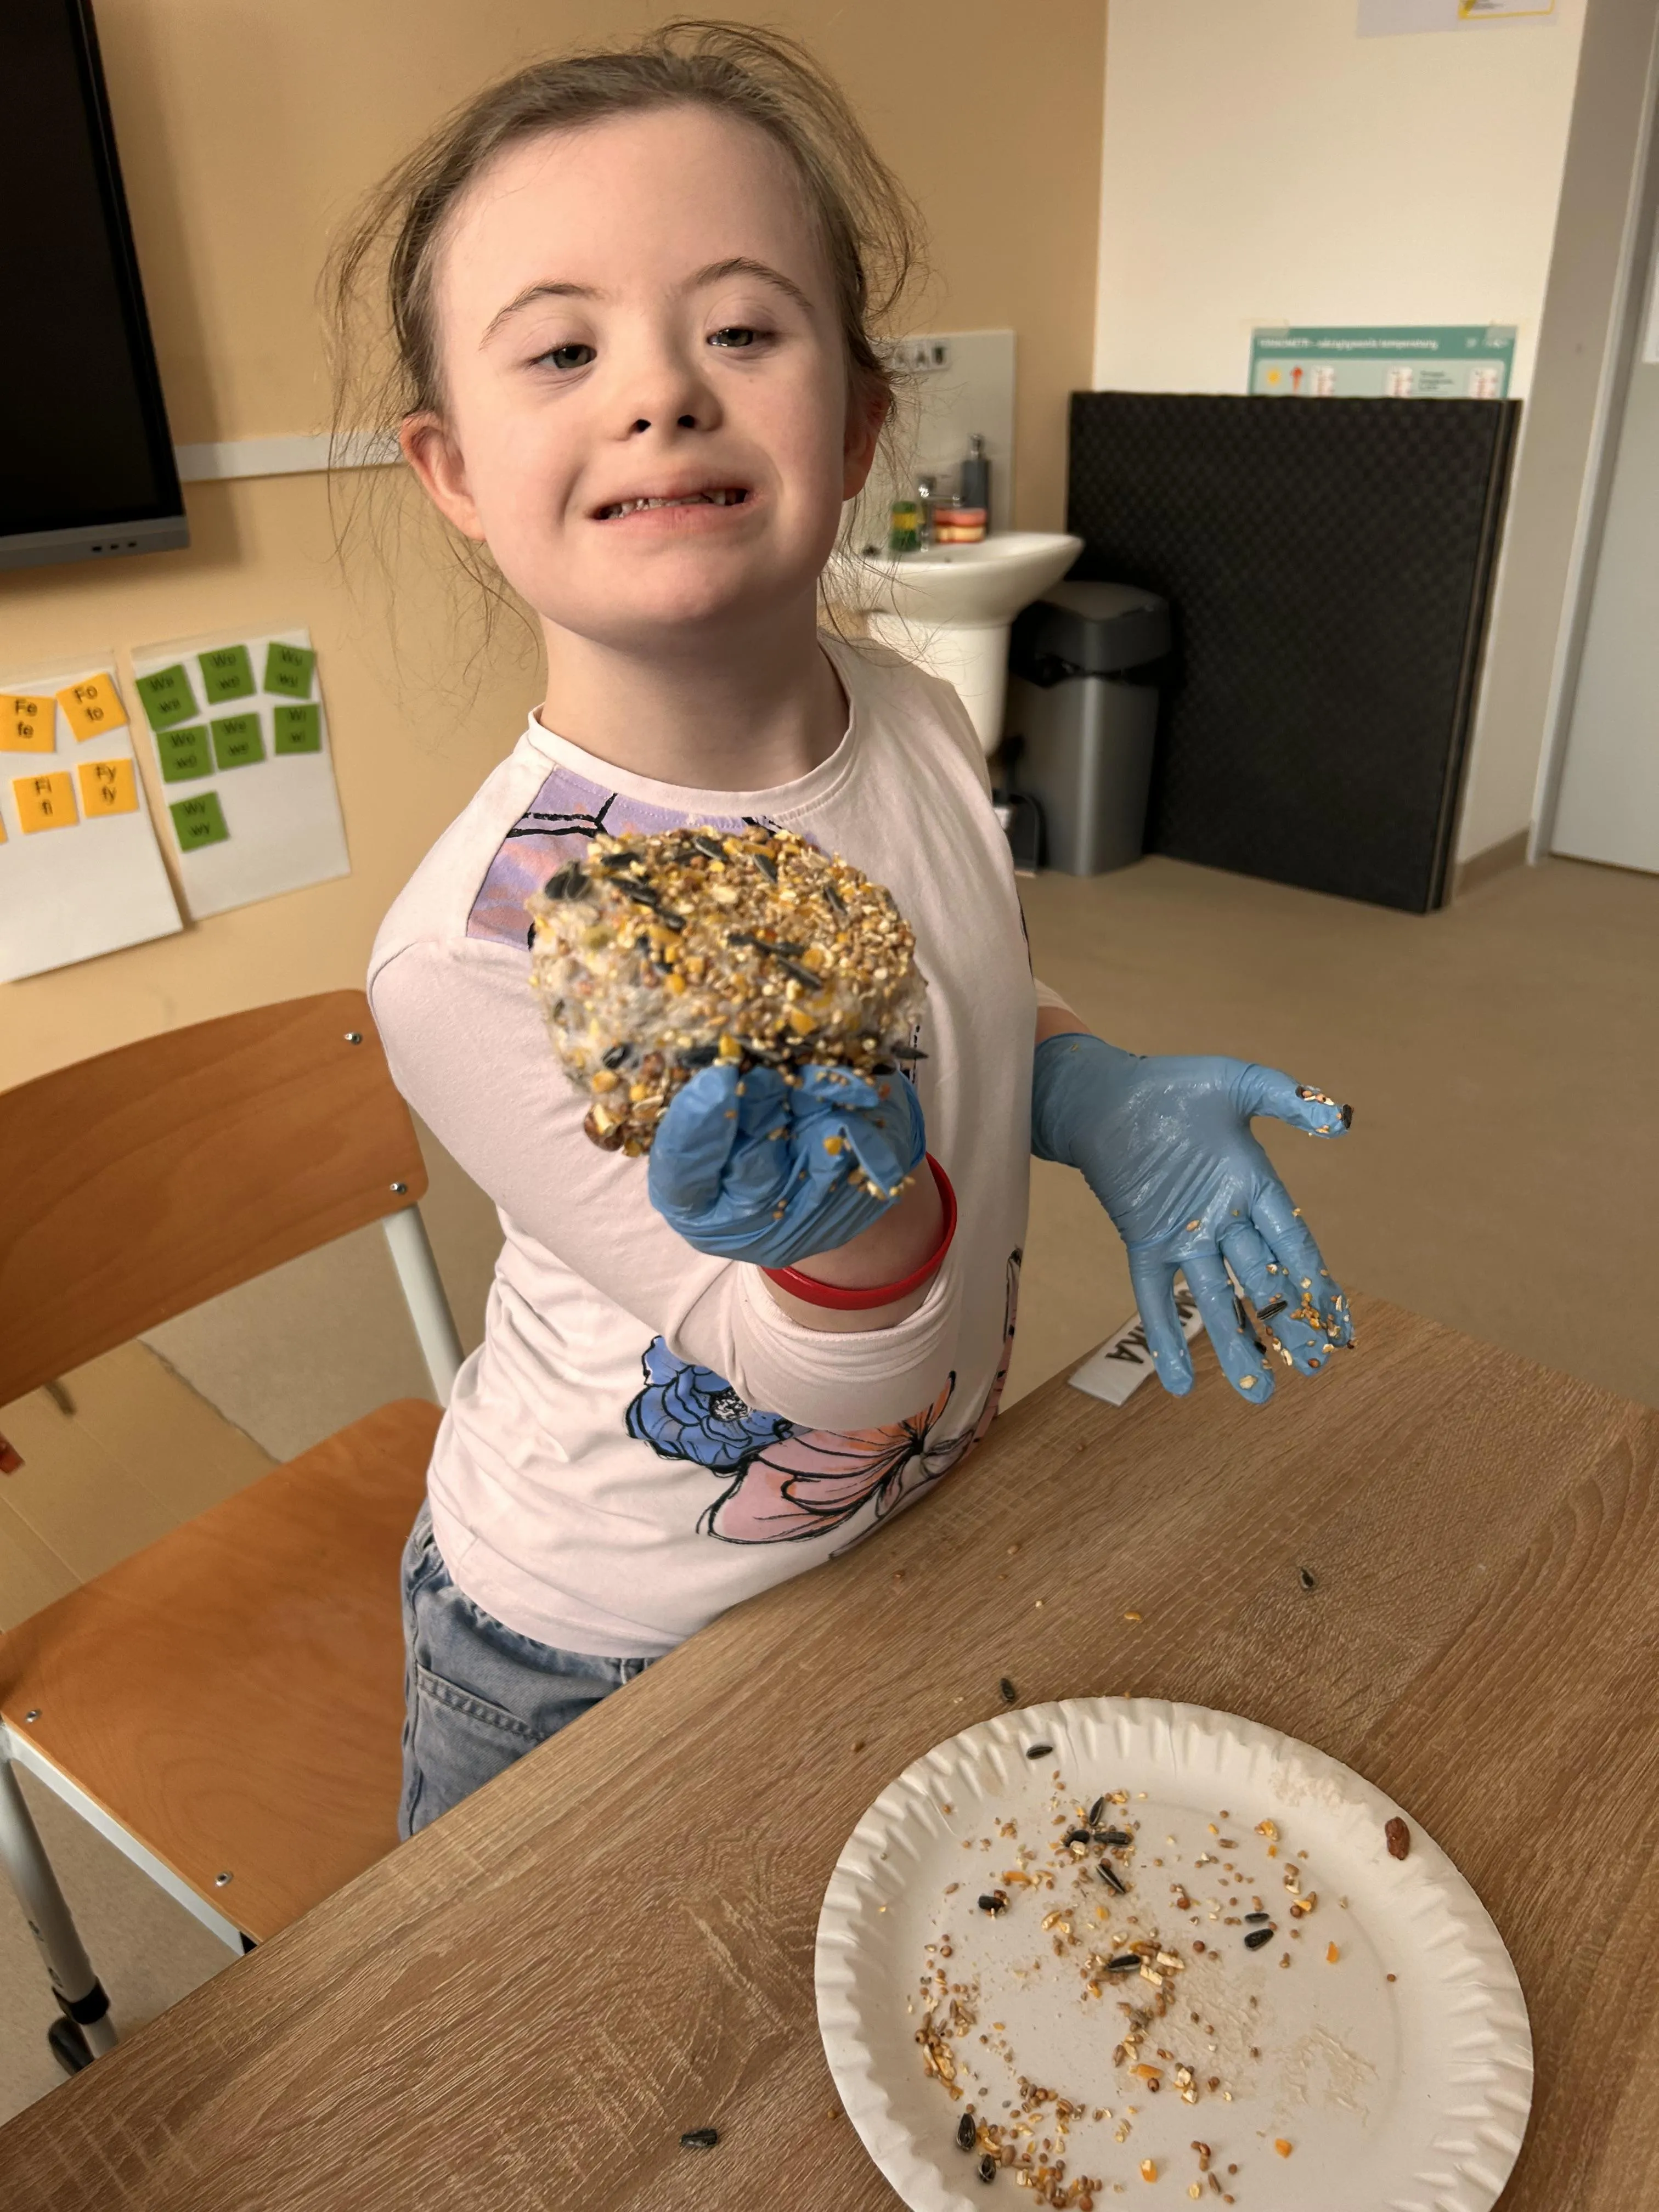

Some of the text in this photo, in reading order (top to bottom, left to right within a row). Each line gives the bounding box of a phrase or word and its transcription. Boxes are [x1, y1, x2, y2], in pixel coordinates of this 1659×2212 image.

[74, 685, 98, 704] Fo
[14, 698, 38, 717] Fe
[85, 706, 104, 723] fo
[17, 720, 34, 739] fe
[94, 763, 117, 784] Fy
